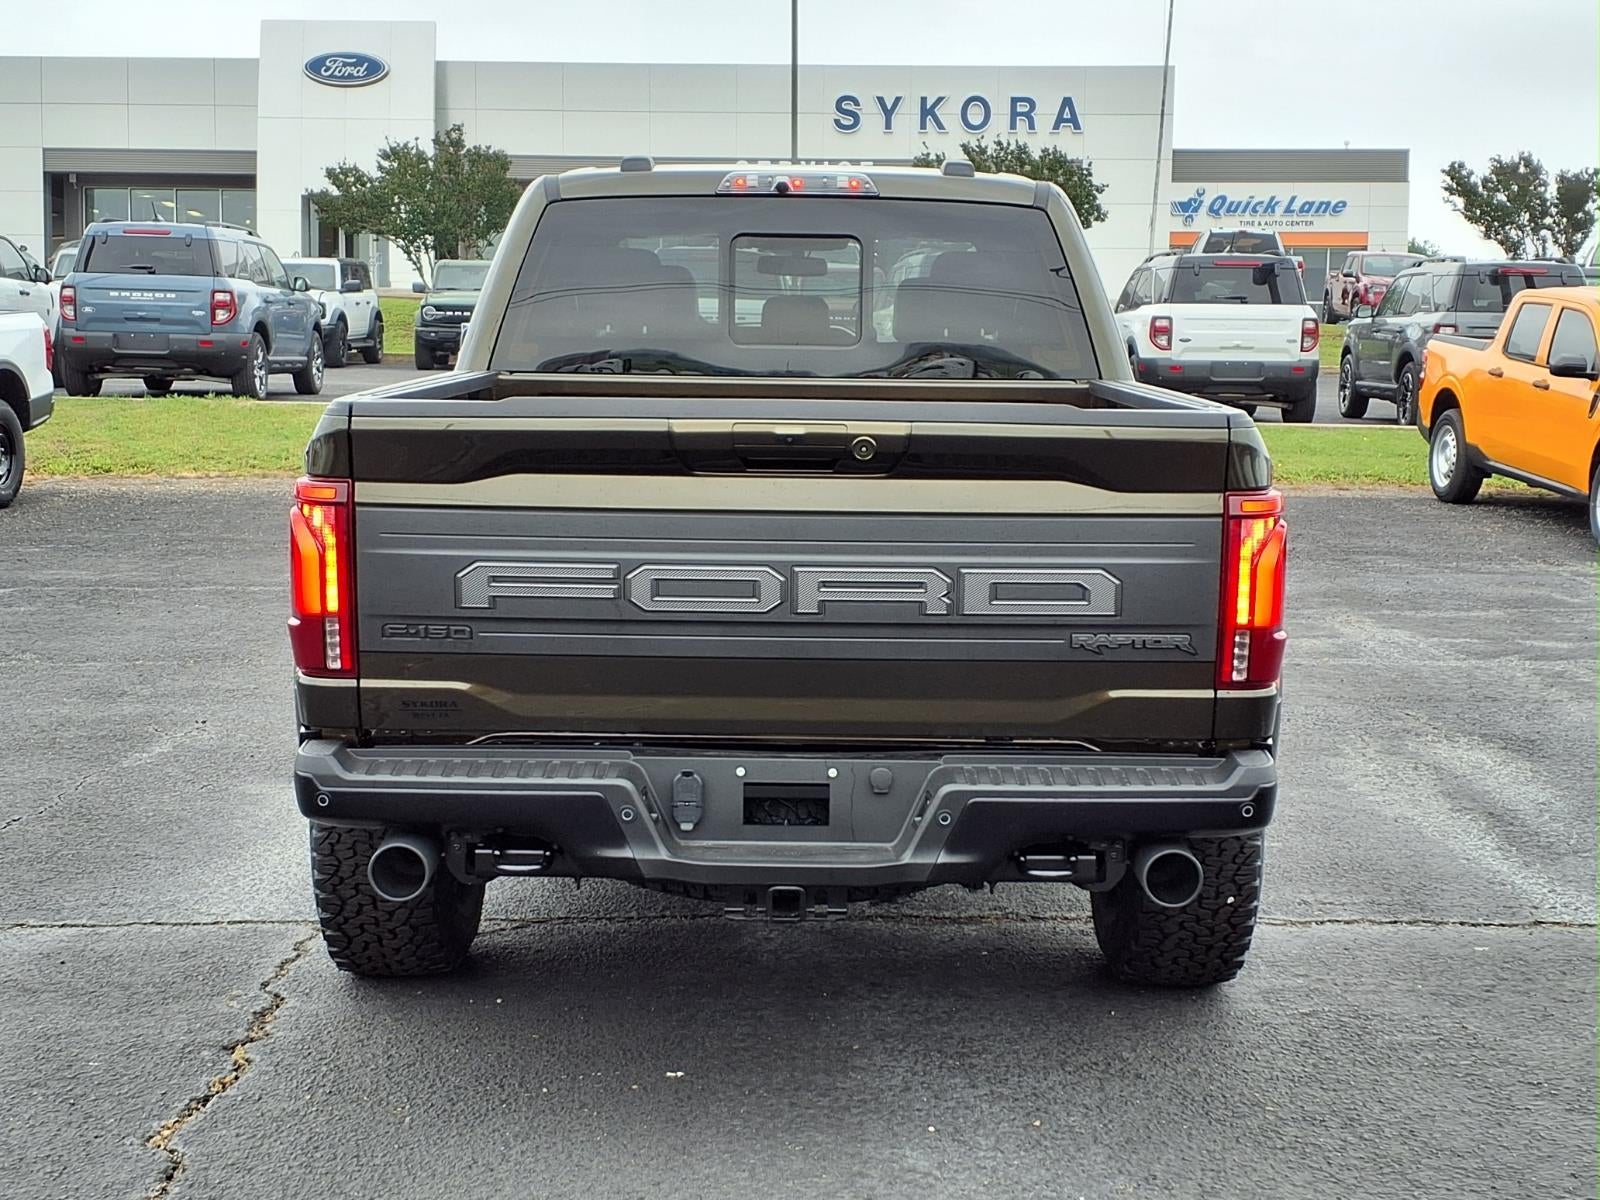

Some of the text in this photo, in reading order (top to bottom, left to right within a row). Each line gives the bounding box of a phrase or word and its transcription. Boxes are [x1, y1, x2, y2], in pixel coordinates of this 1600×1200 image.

[321, 57, 369, 76] Ford
[833, 94, 1083, 133] SYKORA
[1208, 194, 1348, 218] Quick Lane
[455, 561, 1122, 616] FORD
[382, 623, 473, 640] F-150
[1071, 633, 1198, 656] RAPTOR
[400, 700, 458, 709] SYKORA
